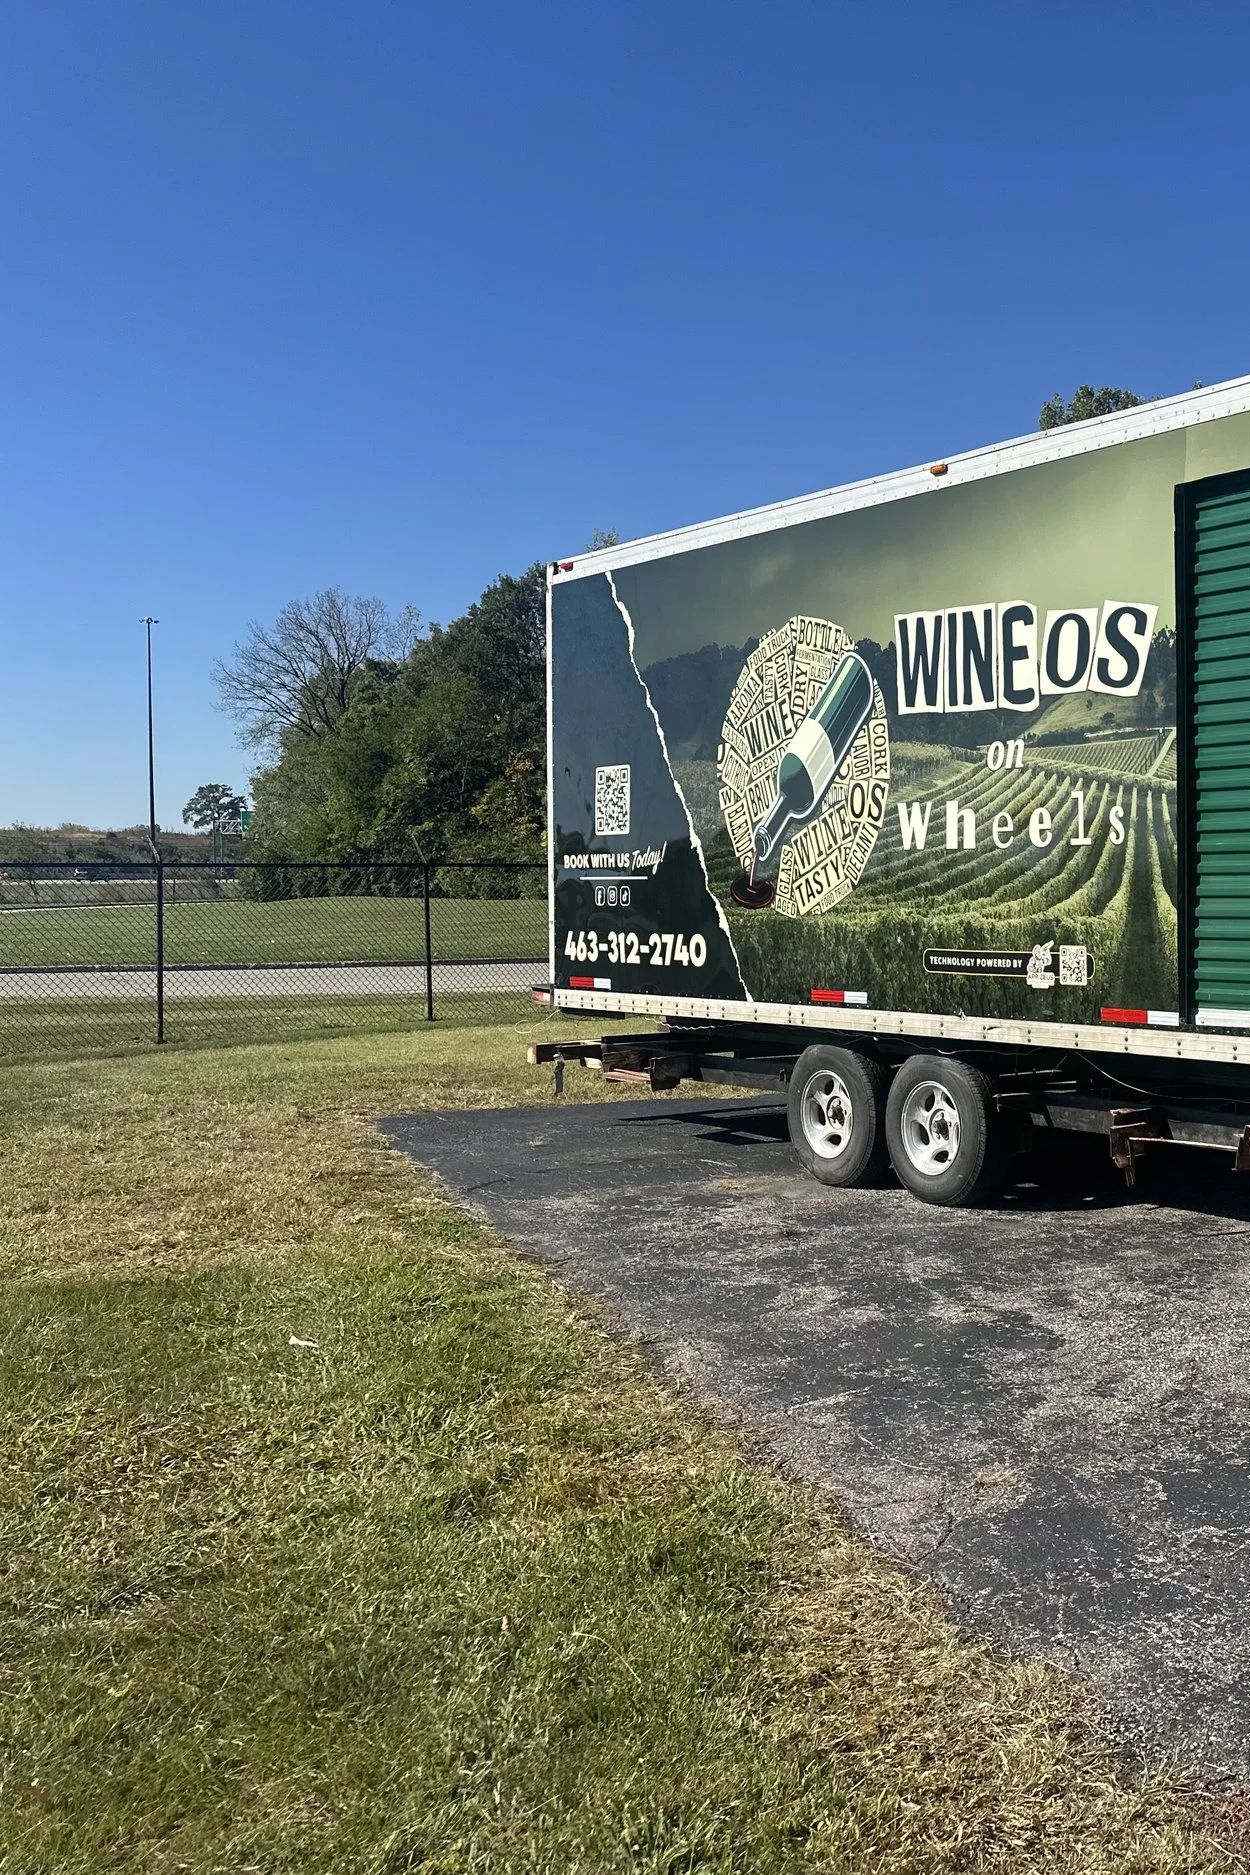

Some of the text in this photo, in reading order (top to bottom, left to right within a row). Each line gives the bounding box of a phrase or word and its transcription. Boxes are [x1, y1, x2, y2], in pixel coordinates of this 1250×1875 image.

[749, 628, 790, 669] FOOD TRUCK
[797, 618, 842, 655] BOTTLE
[897, 604, 1148, 708] WINEOS
[764, 665, 774, 700] TASTY
[774, 652, 791, 697] CORK
[792, 664, 808, 710] DRY
[809, 665, 829, 681] GLASS
[730, 677, 761, 725] AROMA
[723, 723, 749, 758] TANNINS
[744, 697, 793, 759] WINE
[872, 722, 888, 776] CORK
[724, 753, 749, 794] CITRUS
[751, 752, 776, 776] OPEN
[987, 739, 1024, 771] on
[748, 775, 775, 818] BRUT
[727, 802, 753, 853] BLEND
[792, 804, 854, 870] WINE
[563, 841, 667, 875] BOOK WITH US Today!
[778, 848, 794, 895] GLASS
[845, 822, 875, 881] DECANT
[795, 854, 841, 908] TASTY
[776, 898, 796, 917] AGED
[564, 930, 707, 968] 463-312-2740
[929, 956, 1023, 969] TECHNOLOGY POWERED BY
